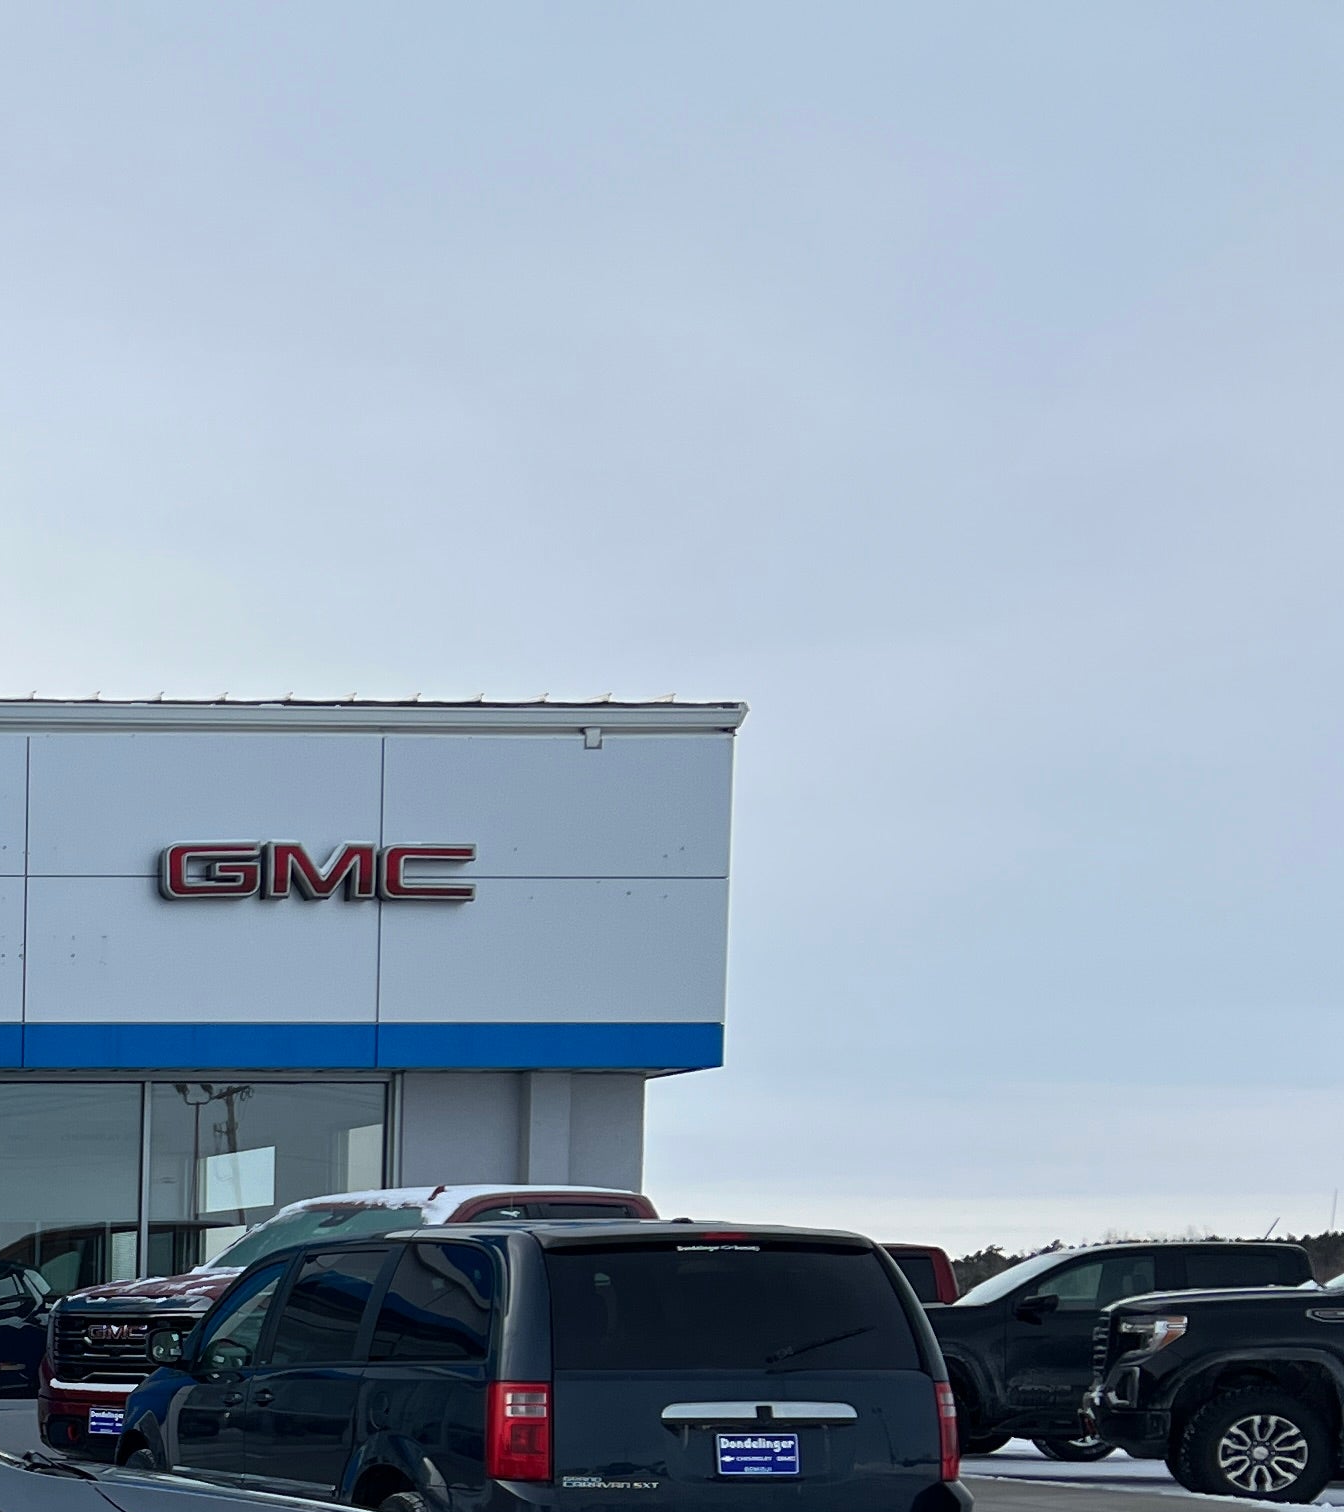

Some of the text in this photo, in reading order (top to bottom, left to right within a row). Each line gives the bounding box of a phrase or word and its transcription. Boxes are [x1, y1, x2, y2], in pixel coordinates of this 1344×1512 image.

[158, 839, 477, 902] GMC
[88, 1324, 149, 1340] GMC
[720, 1437, 795, 1453] Dondelinger
[562, 1481, 631, 1489] CARAVAN
